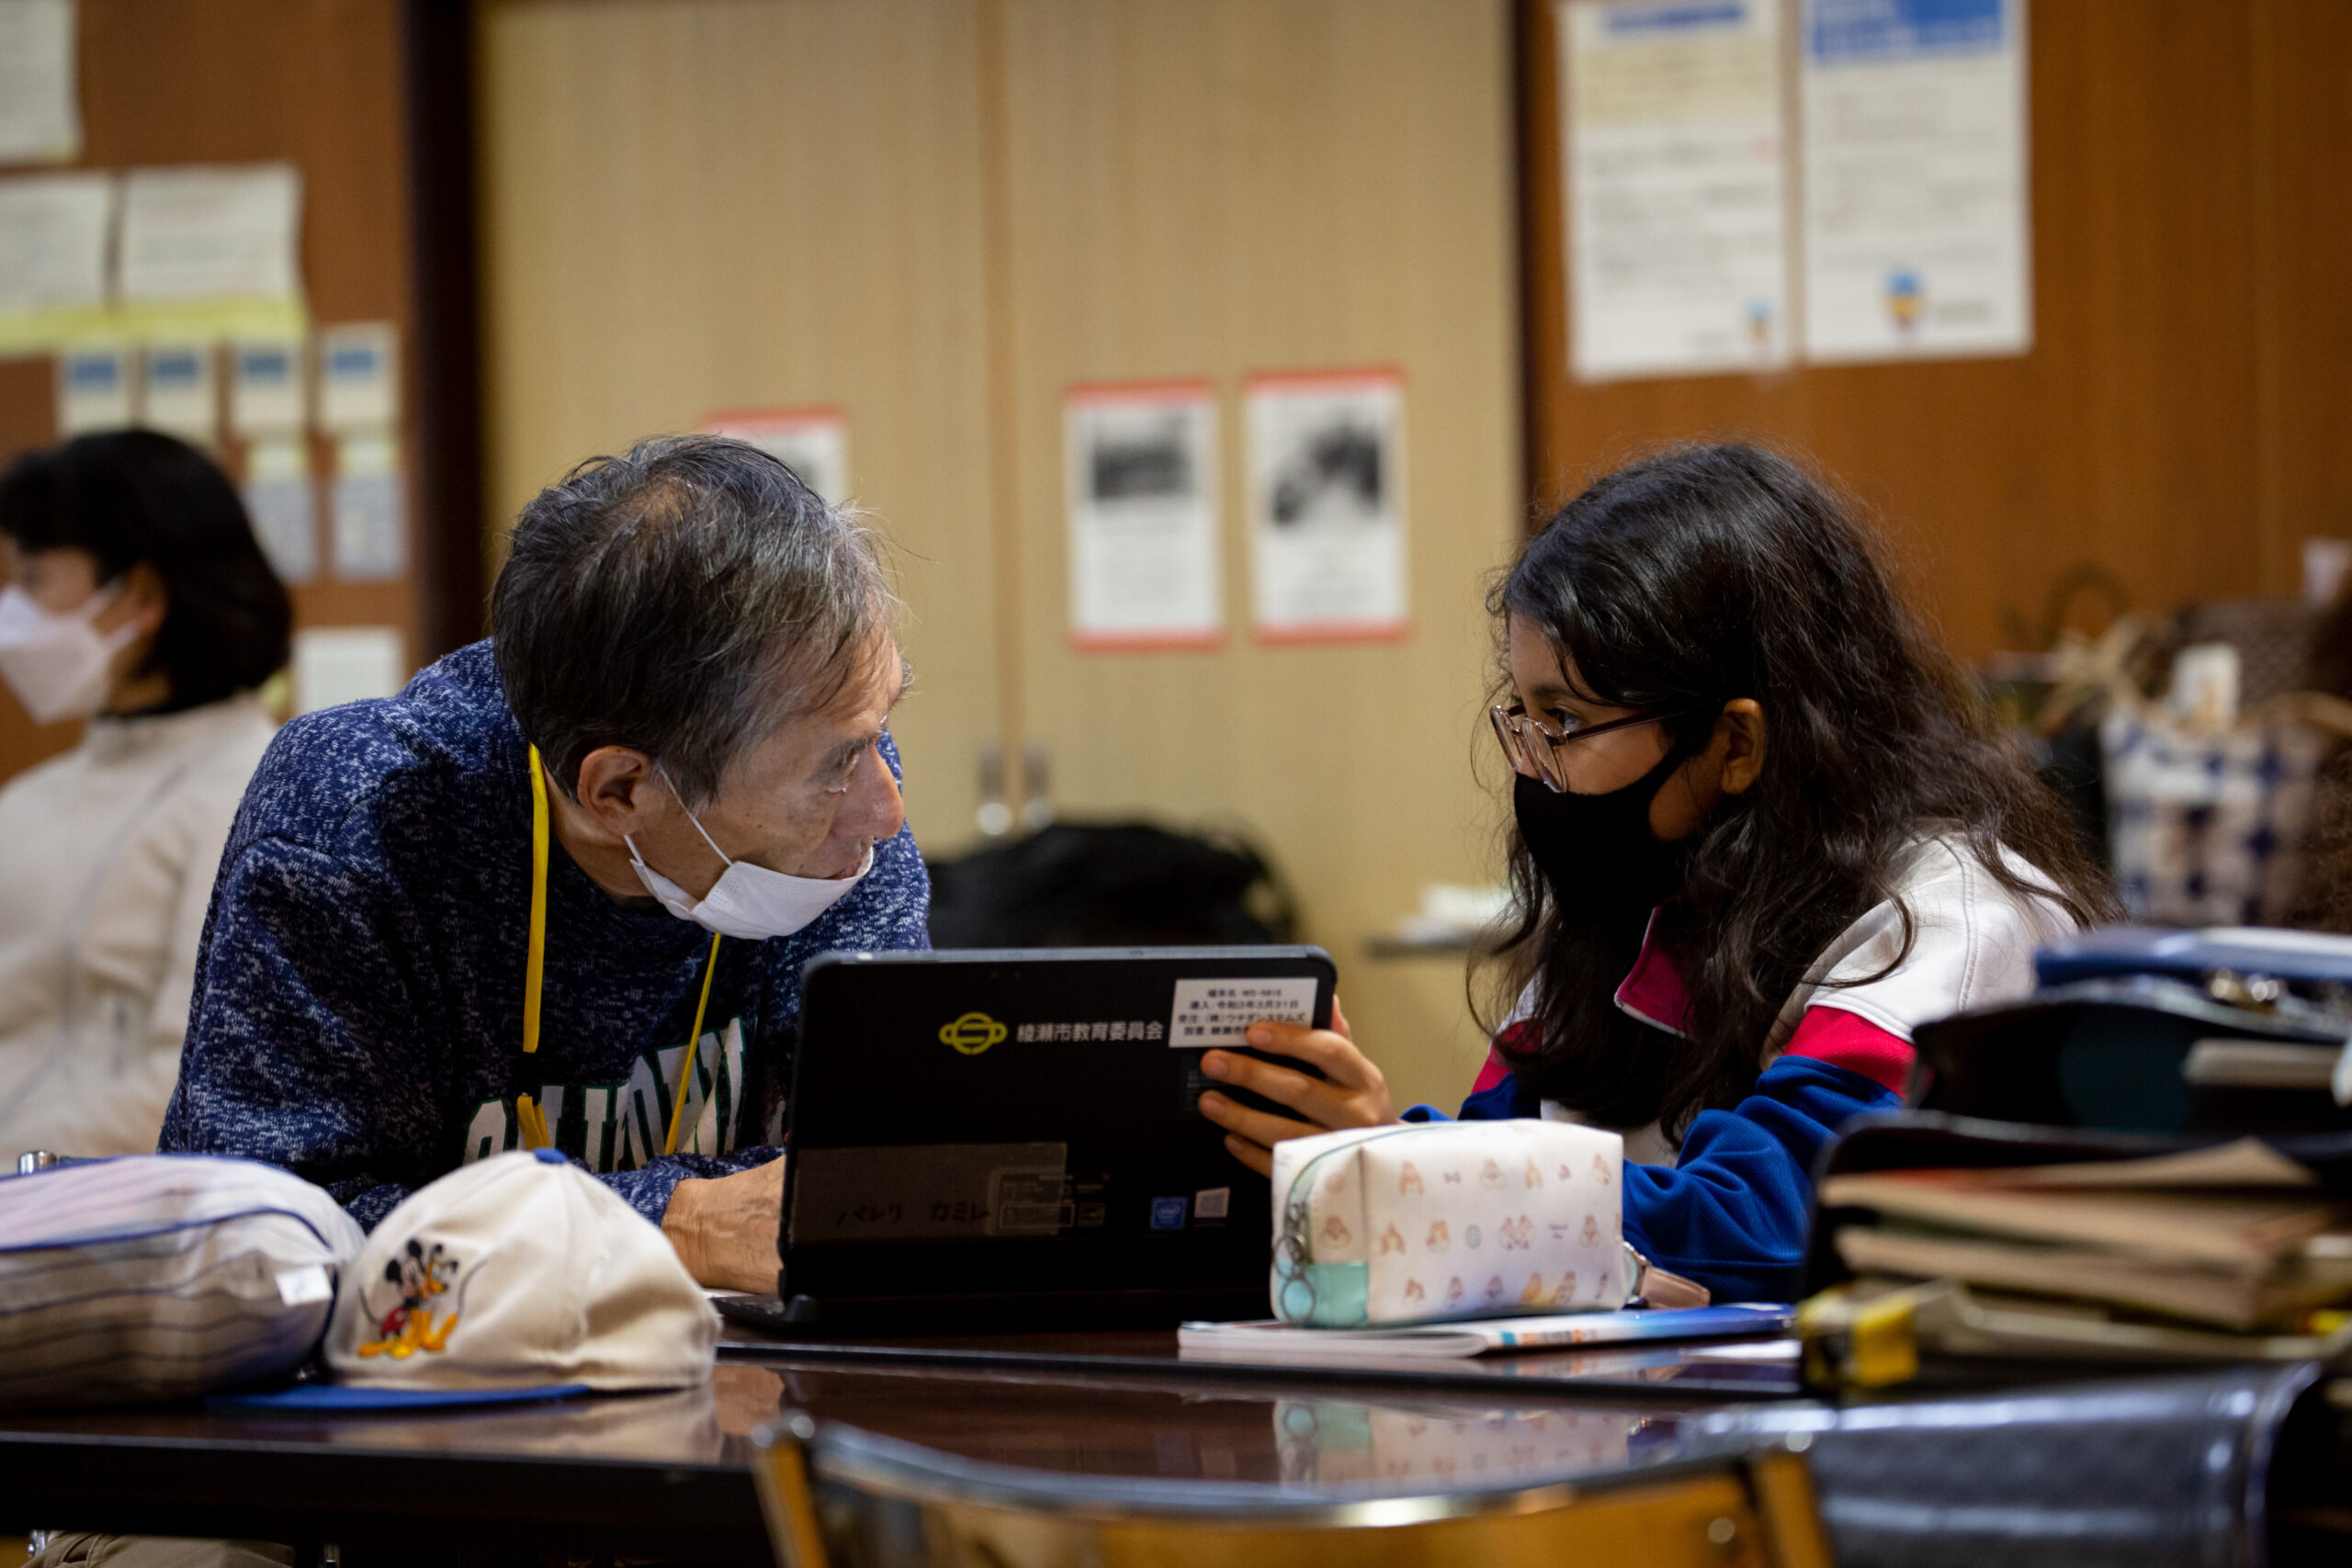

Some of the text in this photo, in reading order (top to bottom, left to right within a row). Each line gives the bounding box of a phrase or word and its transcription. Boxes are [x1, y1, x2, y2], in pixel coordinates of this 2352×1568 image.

[1016, 1021, 1164, 1043] 綾瀬市教育委員会
